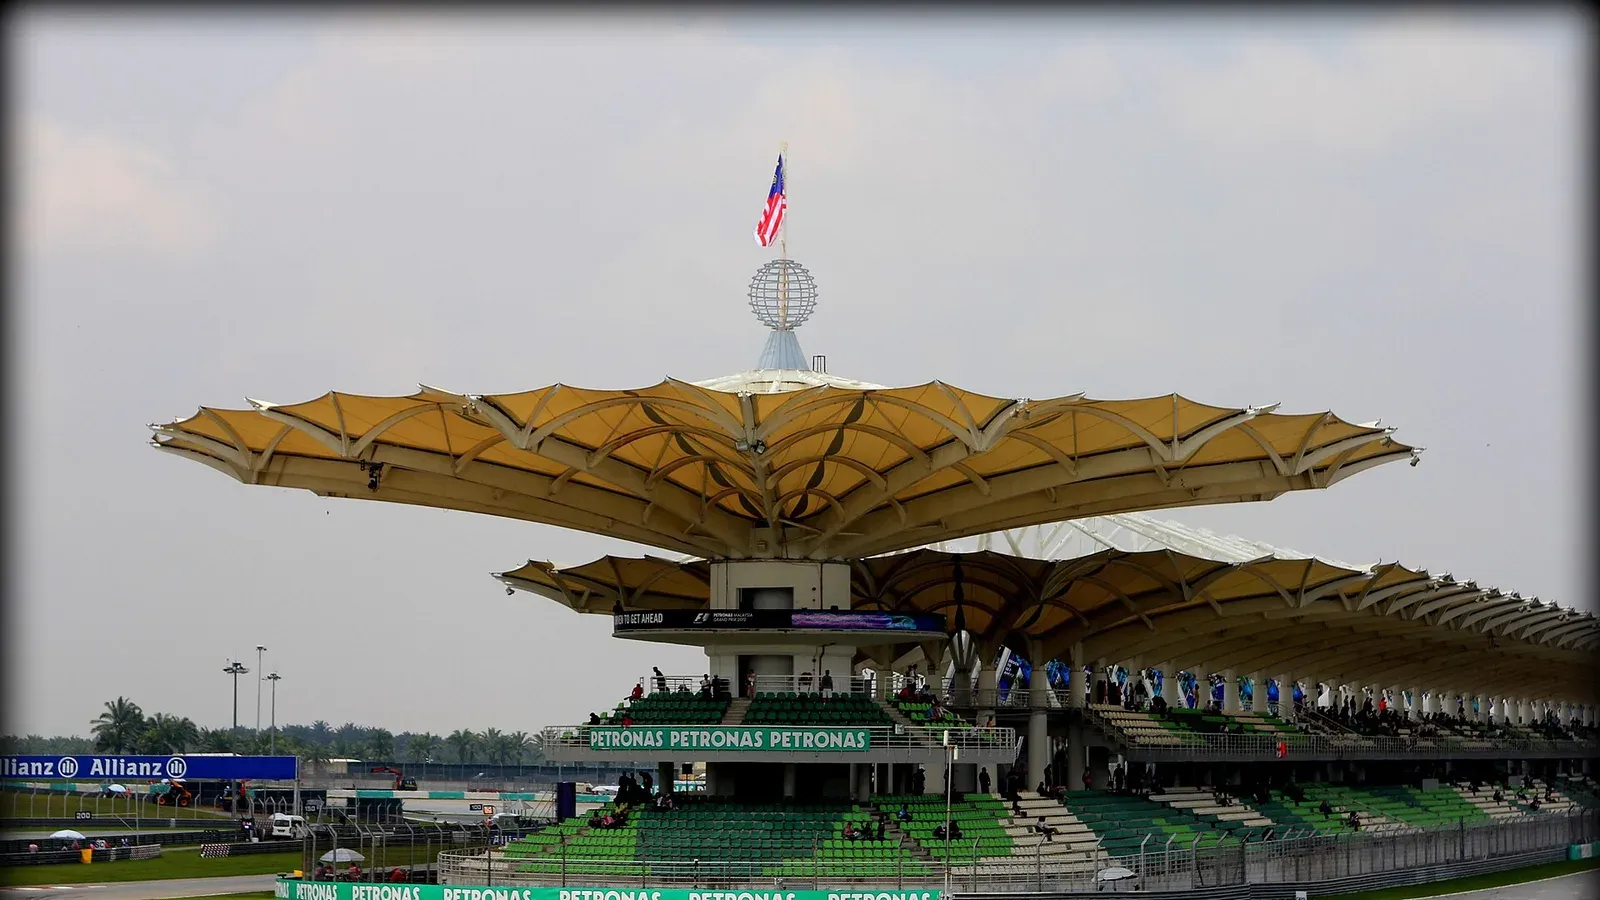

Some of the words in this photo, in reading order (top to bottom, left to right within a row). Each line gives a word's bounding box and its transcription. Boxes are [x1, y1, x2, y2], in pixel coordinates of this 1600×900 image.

[624, 614, 630, 624] TO
[630, 613, 641, 624] GET
[641, 613, 664, 624] AHEAD
[590, 730, 663, 747] PETRONAS
[670, 730, 763, 747] PETRONAS
[770, 731, 866, 748] PETRONAS
[90, 758, 162, 776] Allianz
[76, 812, 91, 820] 200
[296, 883, 338, 900] PETRONAS
[352, 885, 420, 900] PETRONAS
[443, 888, 532, 900] PETRONAS
